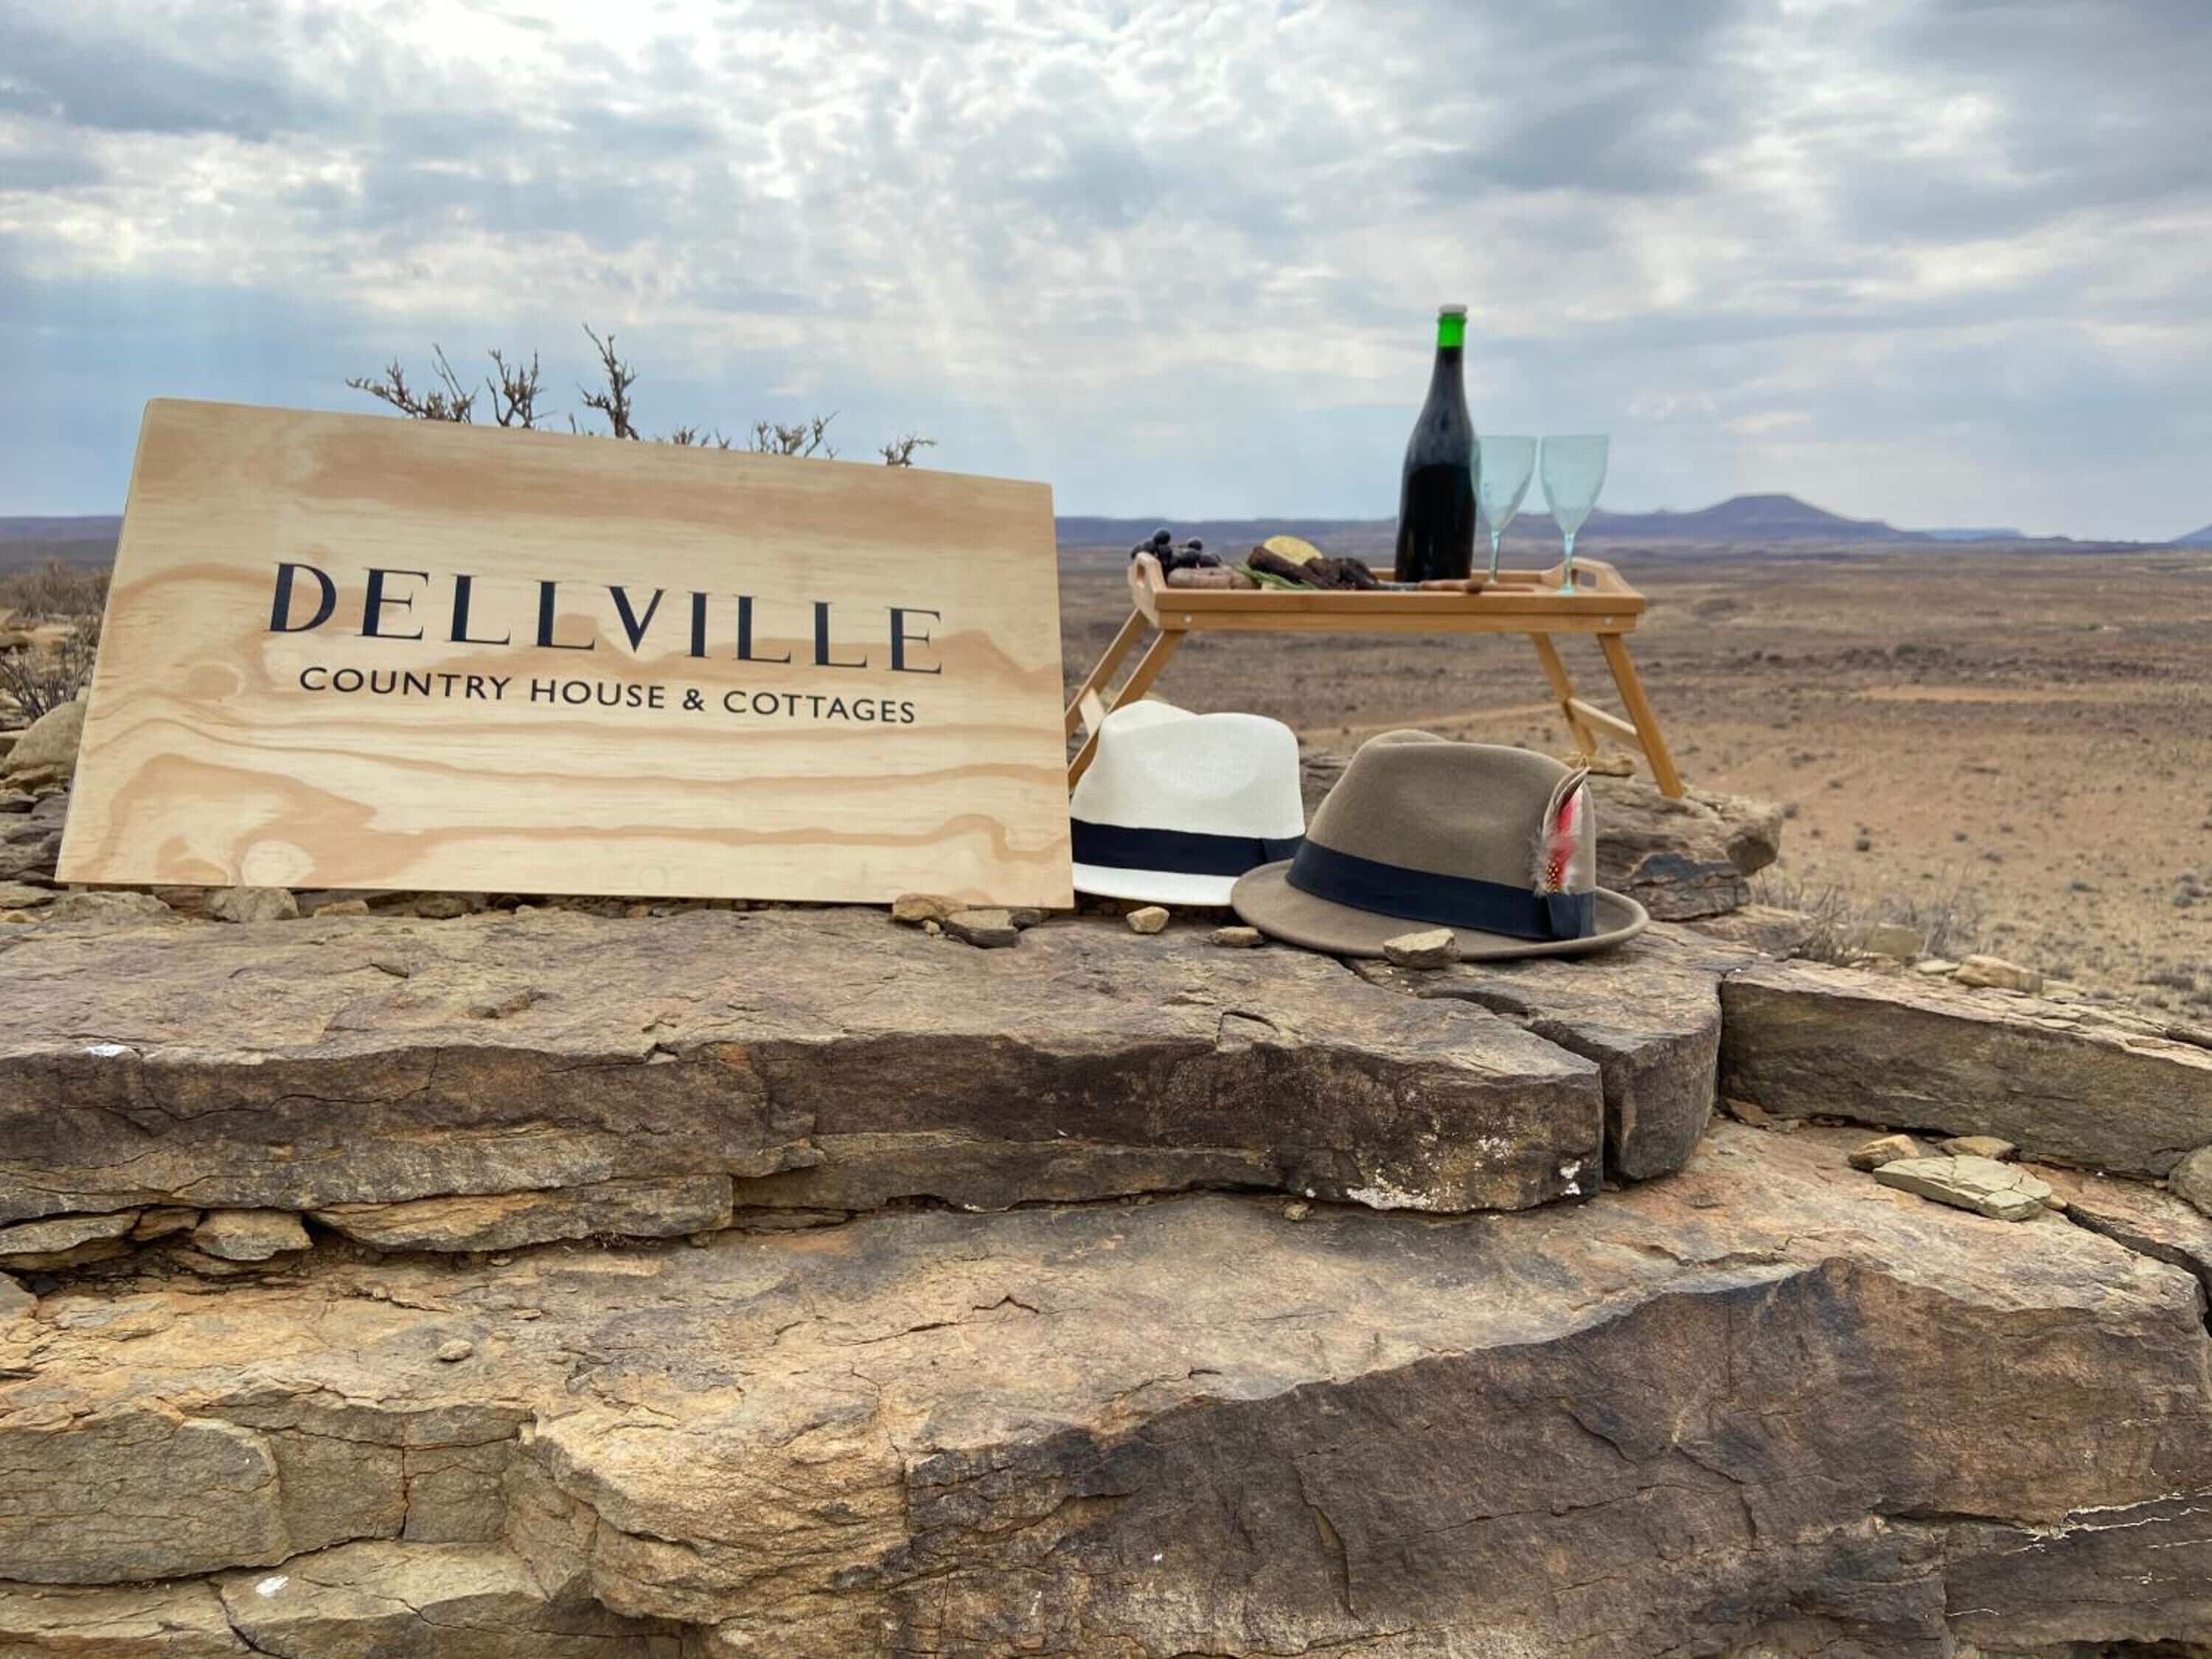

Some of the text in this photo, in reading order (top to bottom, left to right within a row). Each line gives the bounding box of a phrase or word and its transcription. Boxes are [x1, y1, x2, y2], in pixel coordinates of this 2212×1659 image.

[264, 563, 942, 675] DELLVILLE
[299, 666, 917, 724] COUNTRY HOUSE & COTTAGES
